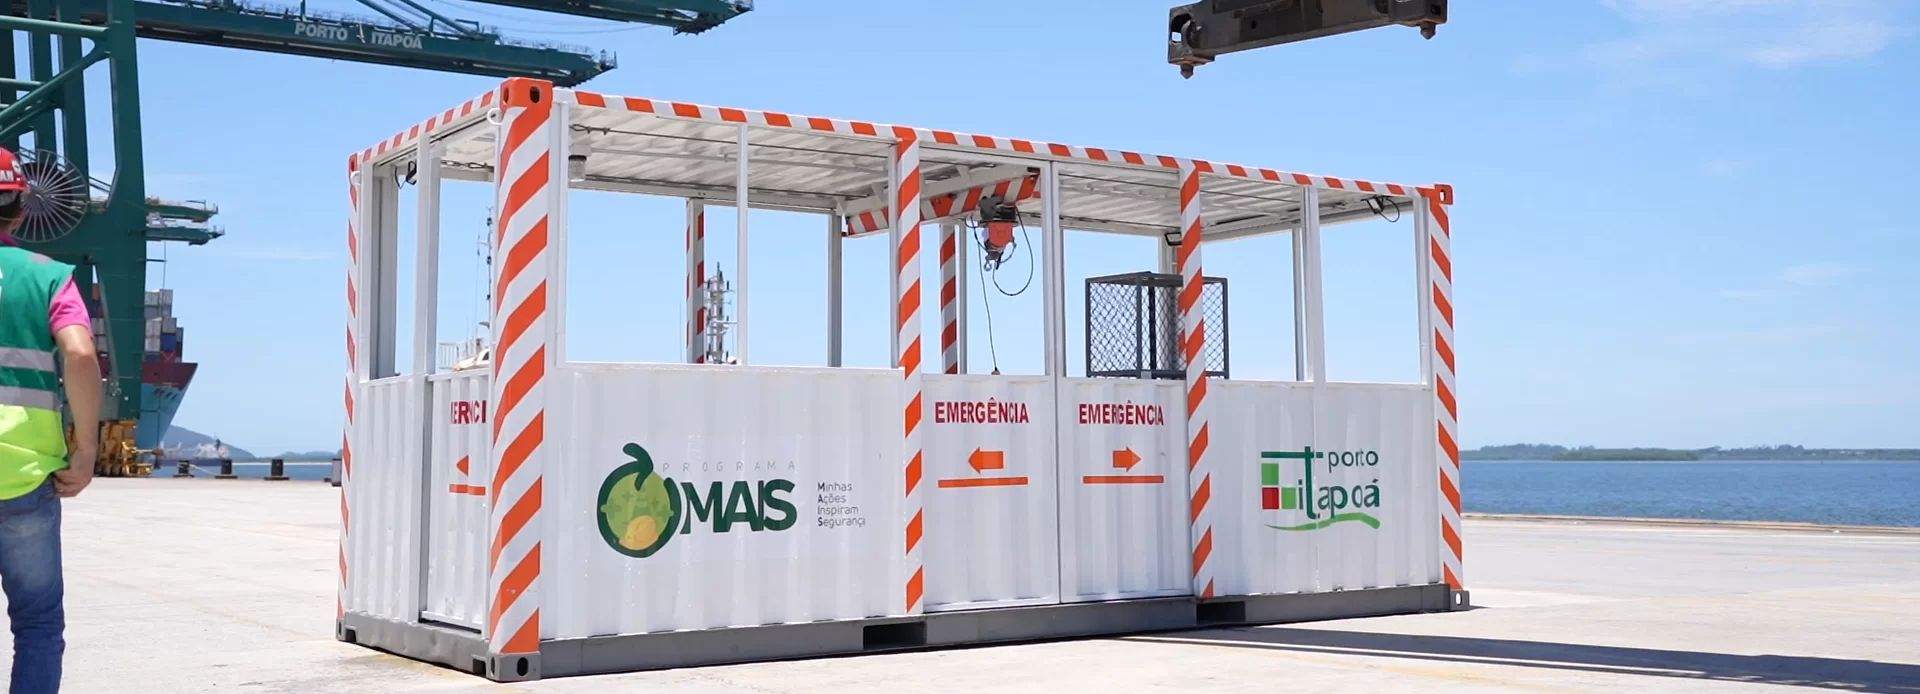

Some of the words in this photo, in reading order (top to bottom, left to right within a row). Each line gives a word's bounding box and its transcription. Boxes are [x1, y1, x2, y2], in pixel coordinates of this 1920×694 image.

[294, 22, 348, 41] PORTO
[935, 397, 1029, 424] EMERGÊNCIA
[1079, 400, 1164, 425] EMERGÊNCIA
[662, 461, 795, 472] PROGRAMA
[1328, 450, 1379, 473] porto
[817, 482, 852, 492] Minhas
[1298, 446, 1380, 519] itapoá
[680, 479, 797, 534] MAIS
[817, 493, 847, 505] Ações
[817, 506, 859, 516] Inspiram
[817, 517, 866, 528] Segurança
